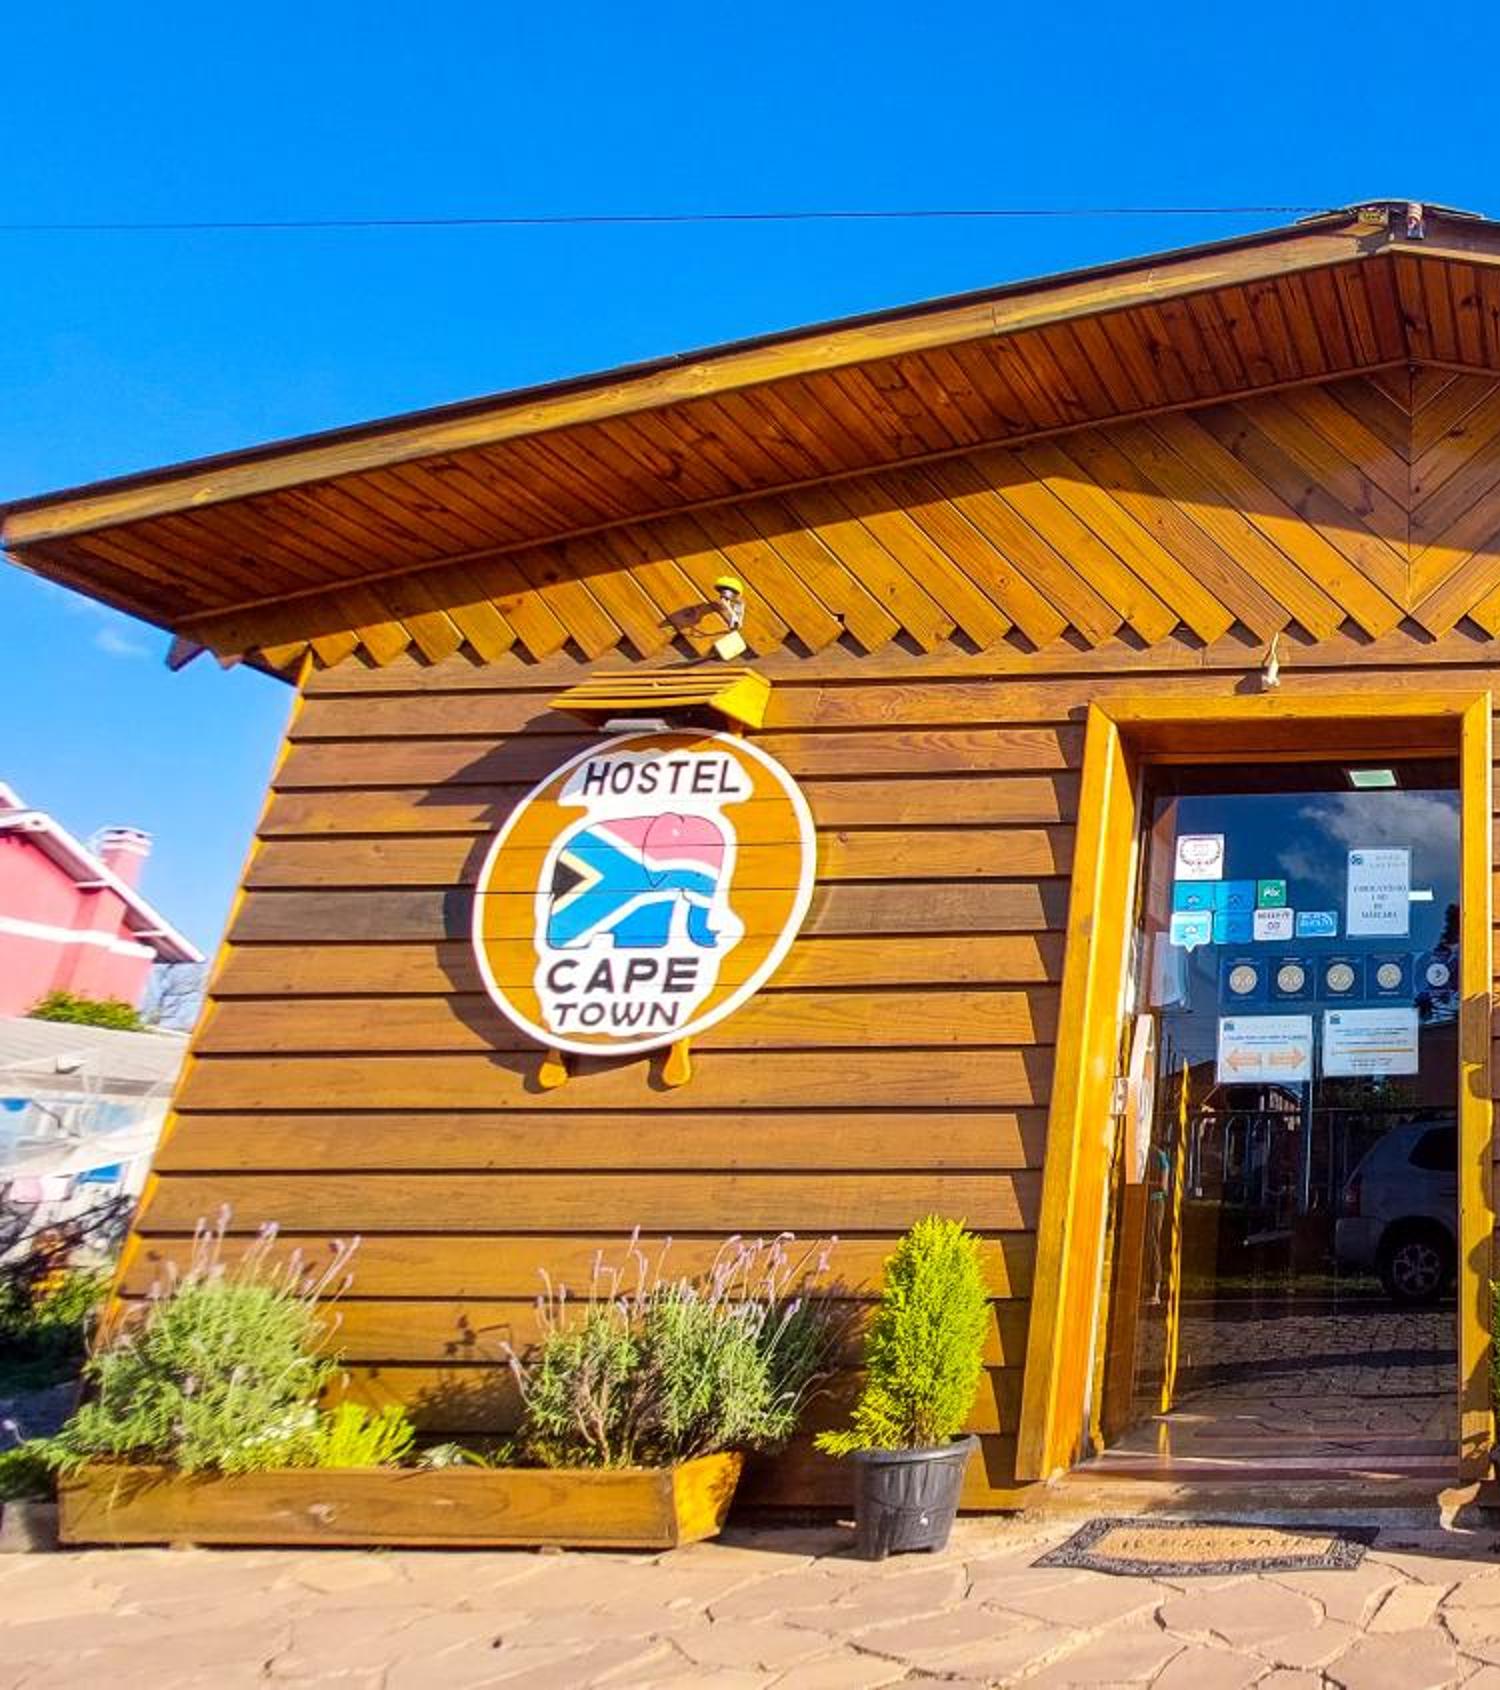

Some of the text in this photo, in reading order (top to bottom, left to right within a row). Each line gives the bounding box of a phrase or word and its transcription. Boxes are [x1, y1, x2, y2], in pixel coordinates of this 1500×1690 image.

[582, 759, 741, 796] HOSTEL
[546, 956, 700, 994] CAPE
[552, 1001, 680, 1027] TOWN
